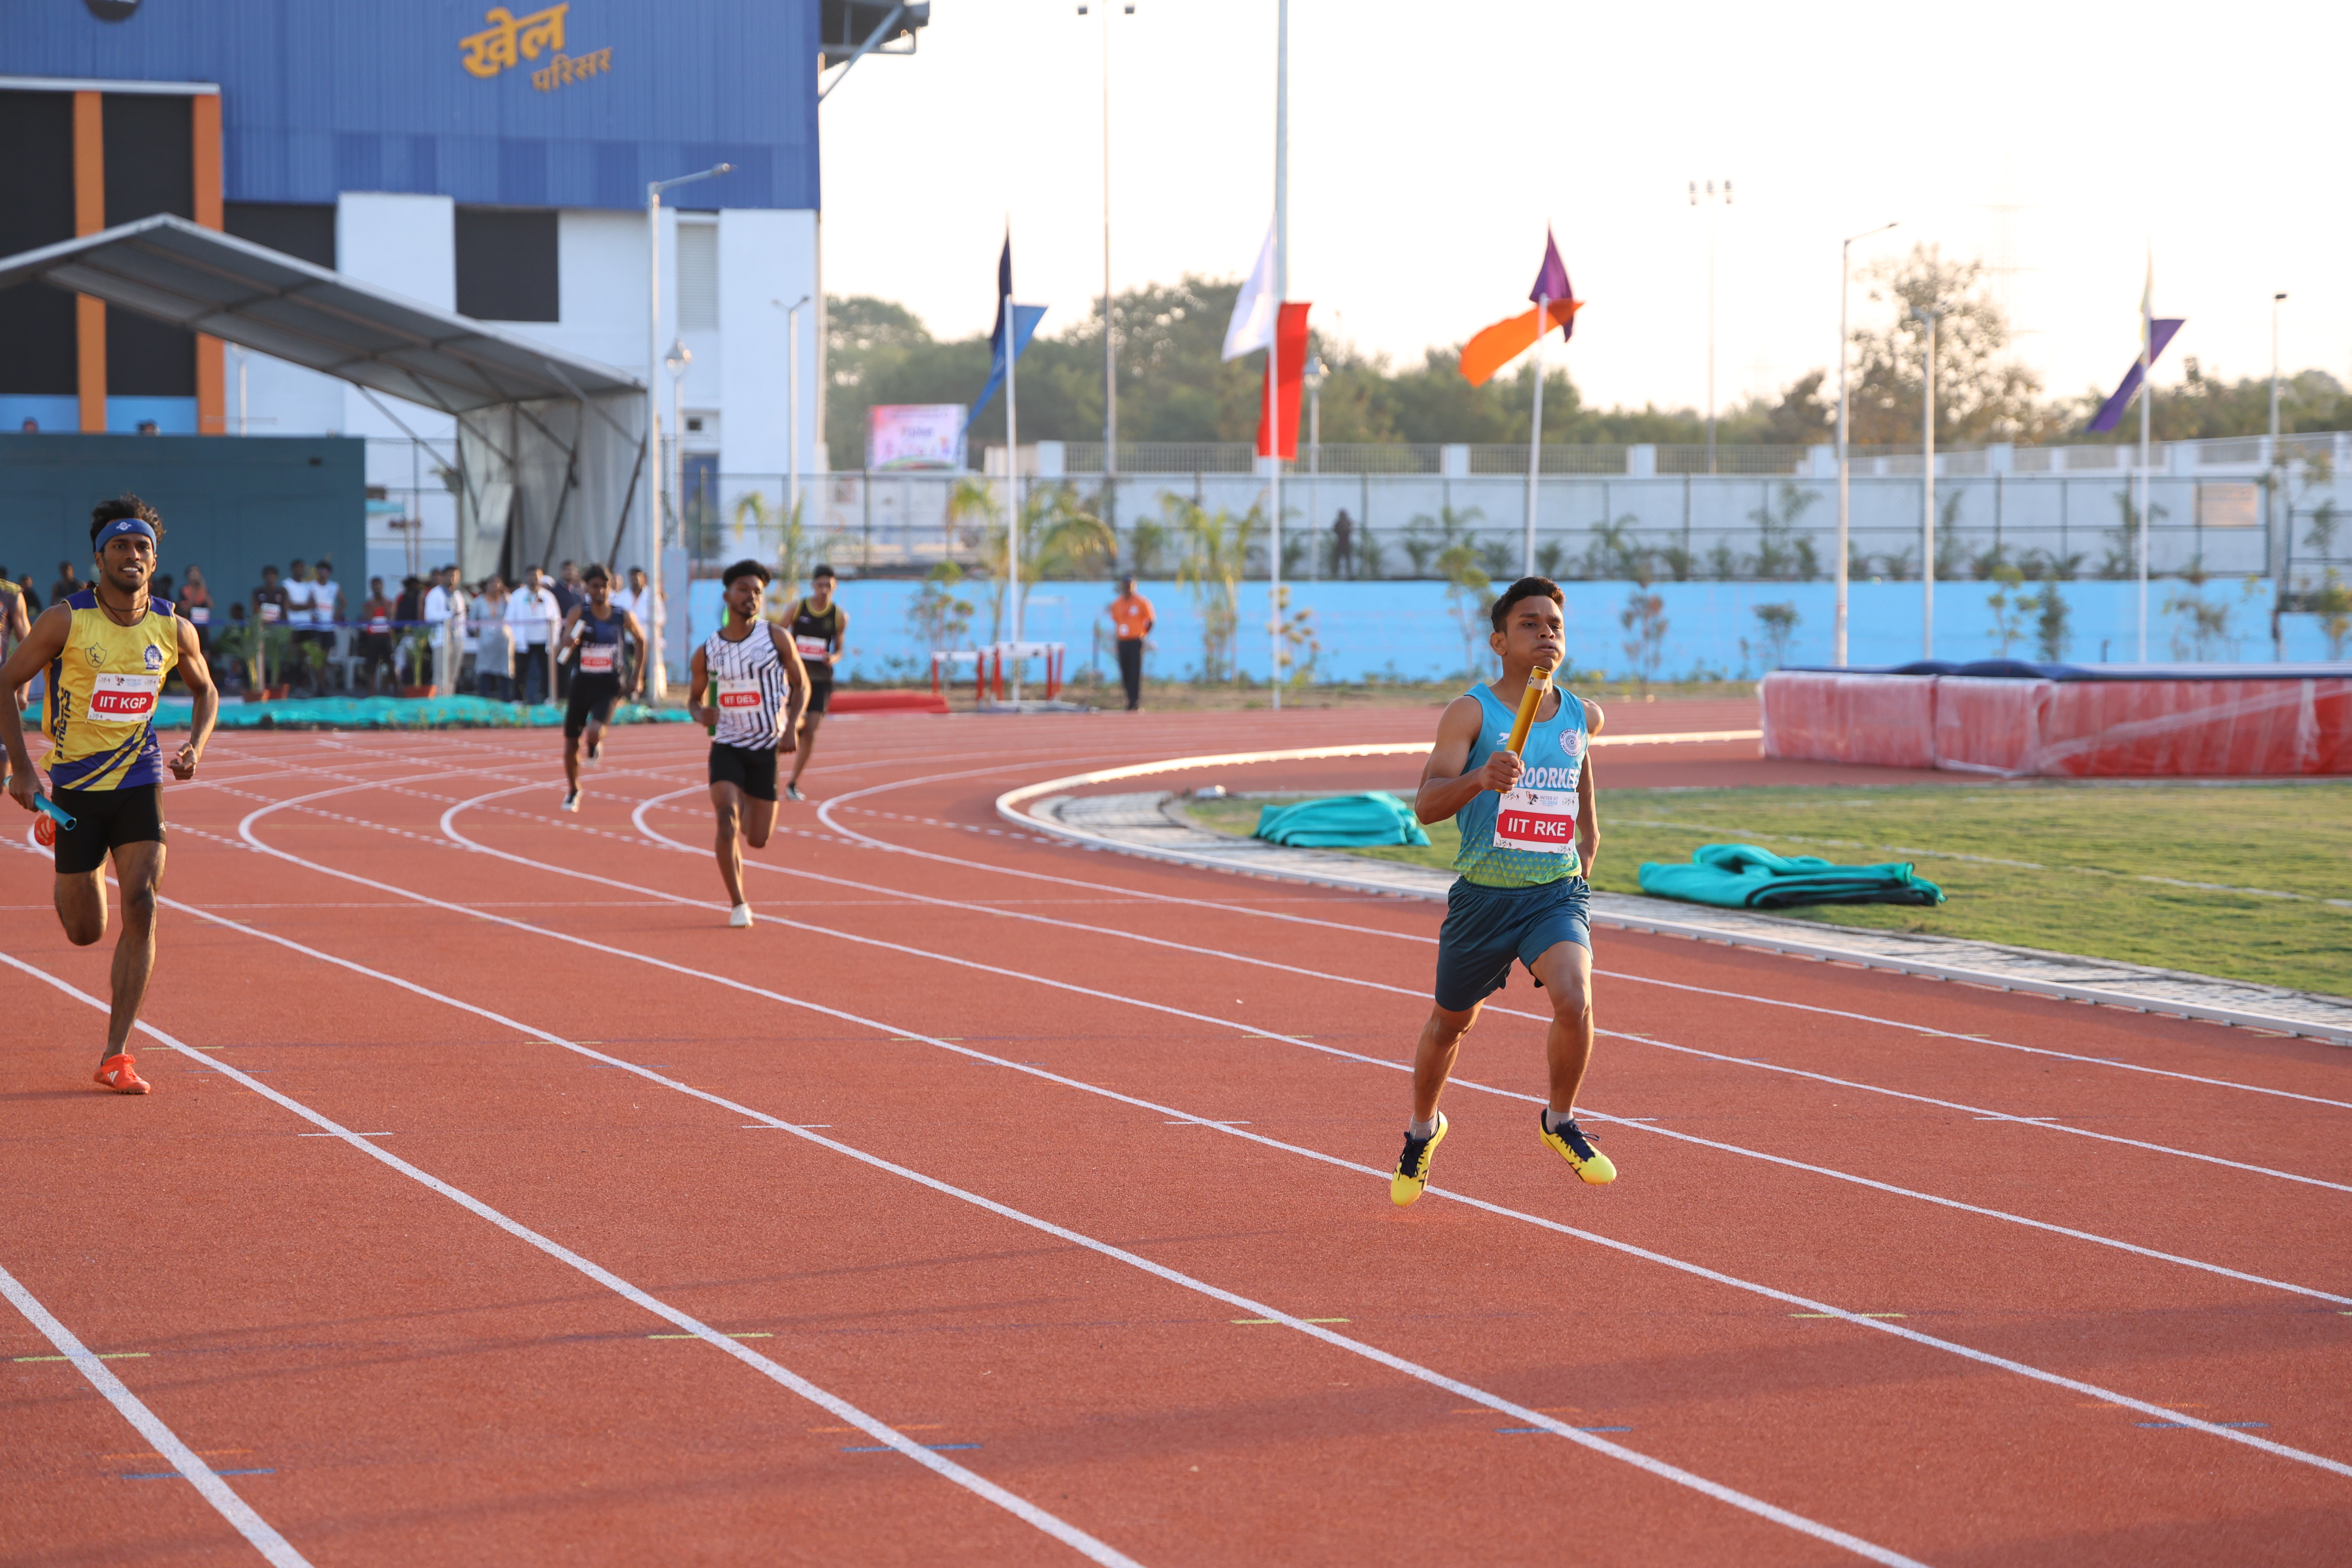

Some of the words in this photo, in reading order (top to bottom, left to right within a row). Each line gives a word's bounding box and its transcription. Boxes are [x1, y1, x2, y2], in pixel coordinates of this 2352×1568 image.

[459, 2, 569, 78] खेल
[531, 47, 613, 93] परिसर
[99, 696, 117, 708] IIT
[120, 697, 147, 709] KGP
[736, 694, 756, 705] DEL
[1508, 818, 1530, 833] IIT
[1534, 820, 1567, 837] RKE
